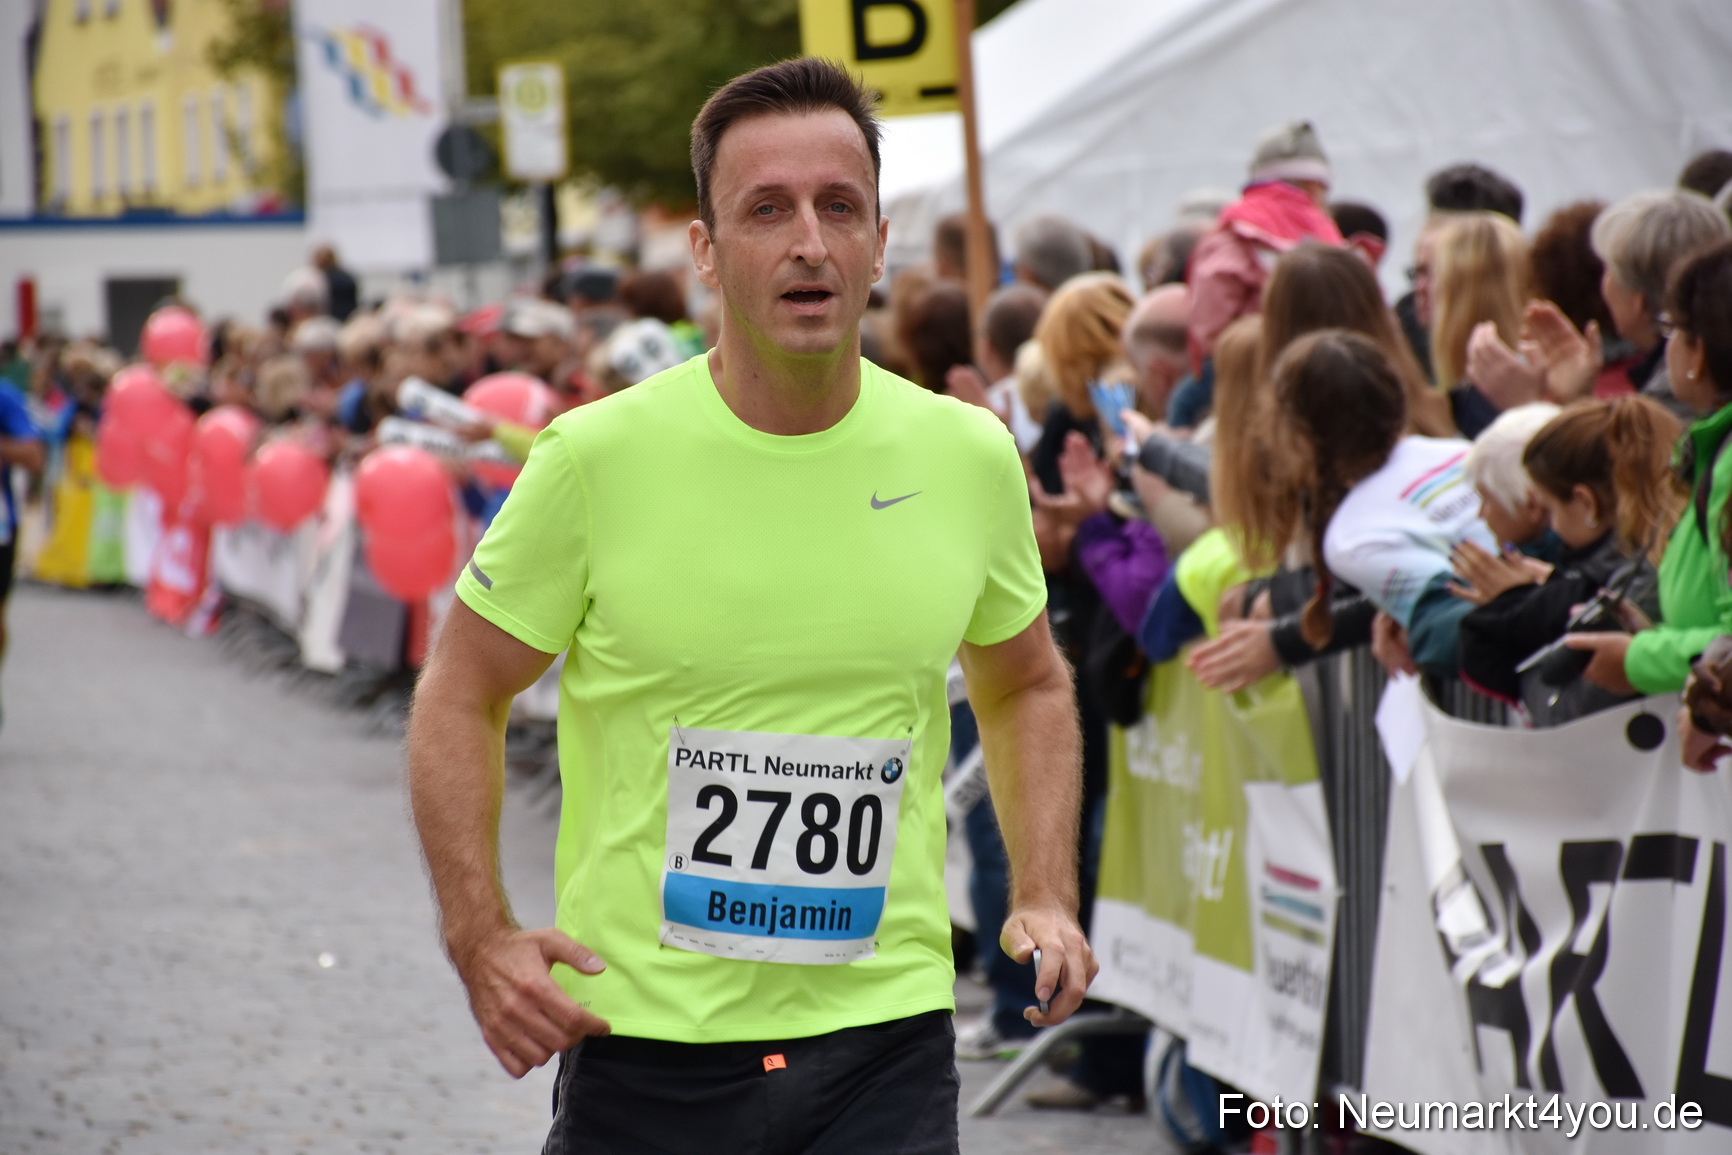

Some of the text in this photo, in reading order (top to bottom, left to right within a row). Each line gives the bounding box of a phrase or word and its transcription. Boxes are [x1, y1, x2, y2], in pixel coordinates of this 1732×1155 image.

[675, 747, 874, 781] PARTL Neumarkt
[691, 783, 883, 876] 2780
[707, 890, 852, 935] Benjamin
